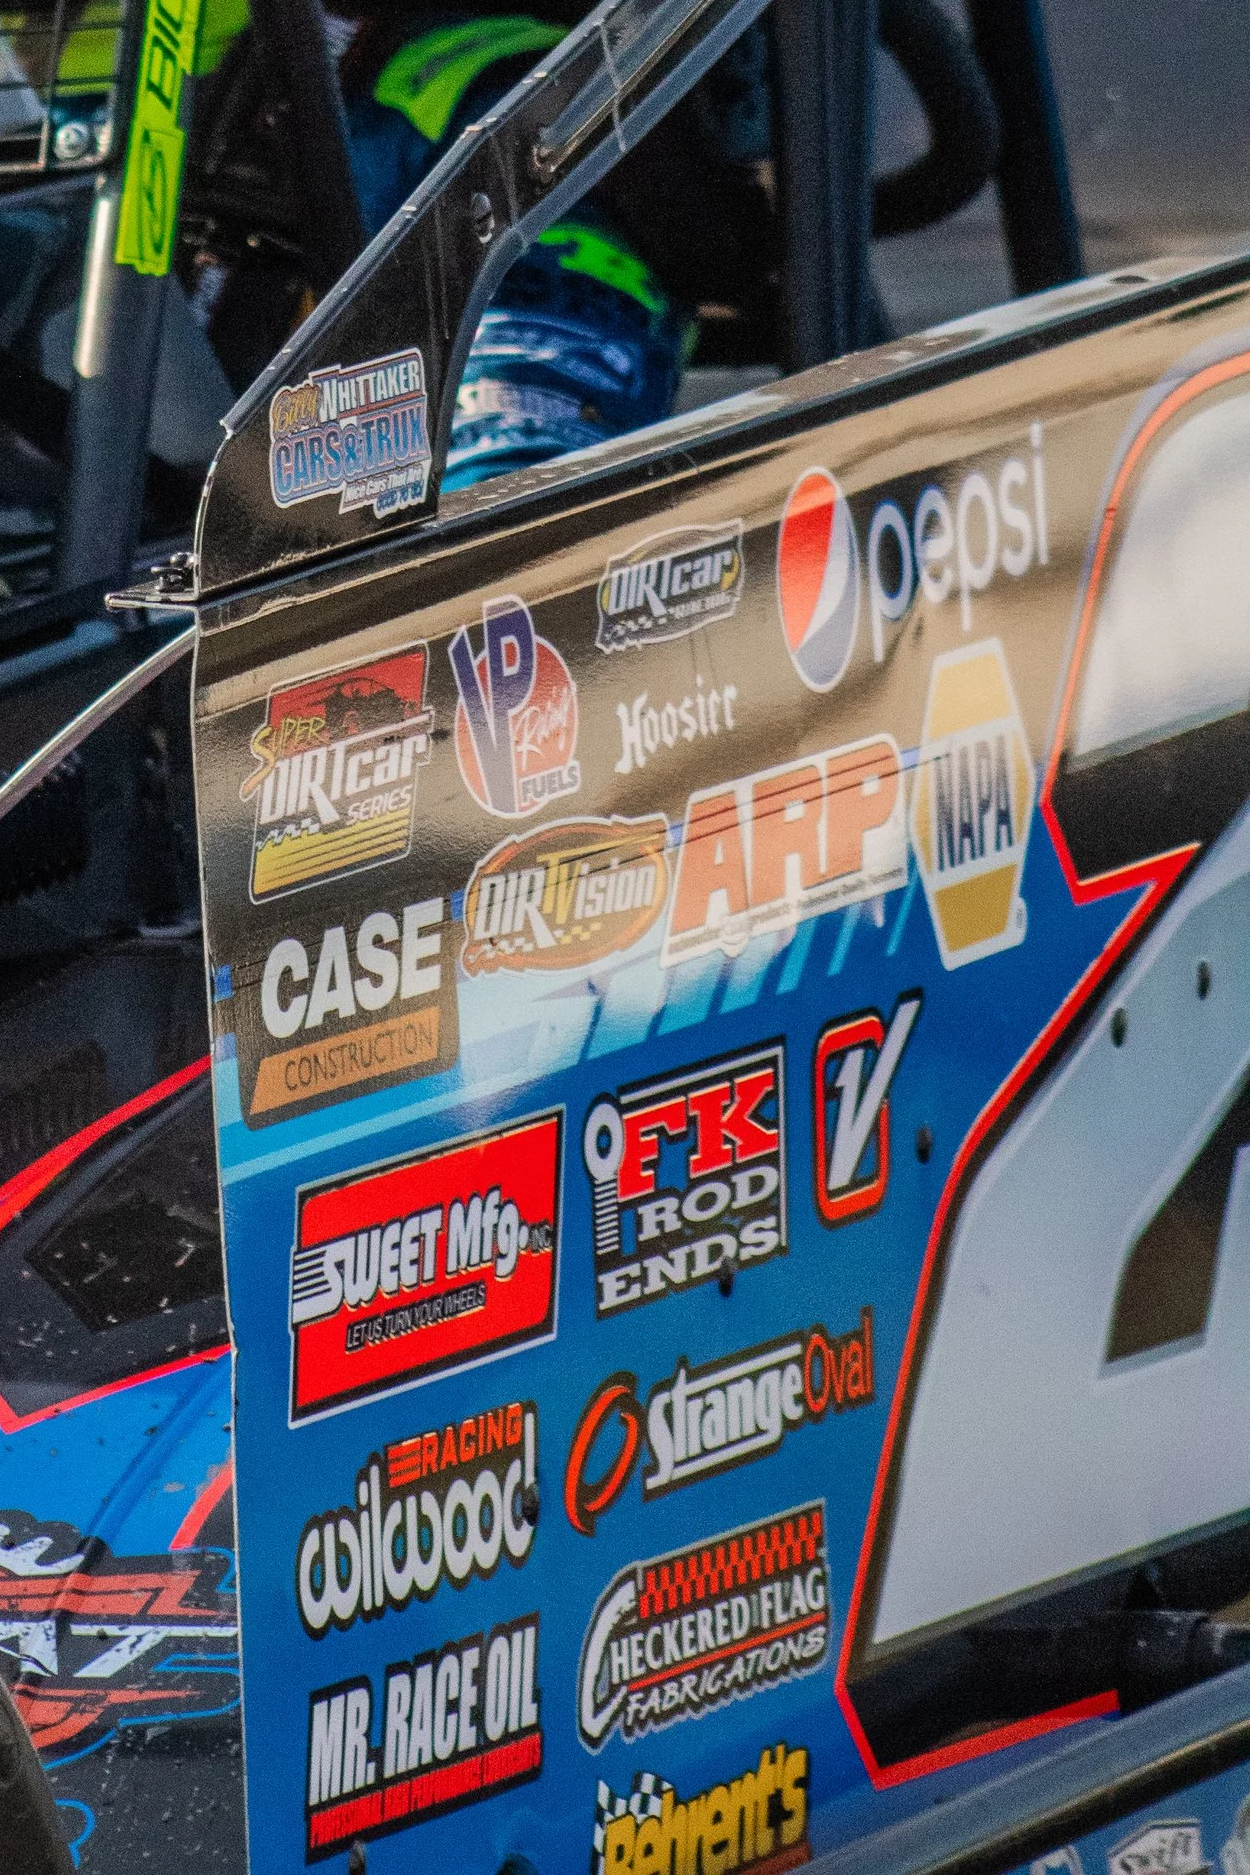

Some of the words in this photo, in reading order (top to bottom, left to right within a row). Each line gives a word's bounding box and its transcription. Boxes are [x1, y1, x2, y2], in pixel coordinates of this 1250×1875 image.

[318, 359, 421, 424] WHITTAKER
[607, 549, 735, 617] DIRTcar
[866, 419, 1051, 664] pepsi
[450, 597, 537, 816] VP
[259, 732, 428, 826] DIRTcar
[346, 783, 415, 826] SERIES
[521, 763, 580, 804] FUELS
[932, 733, 1016, 875] NAPA
[669, 741, 902, 937] ARP
[260, 896, 445, 1039] CASE
[283, 1020, 434, 1092] CONSTRUCTION
[616, 1067, 780, 1203] FK
[638, 1165, 781, 1242] ROD
[292, 1206, 443, 1325] SWEET
[597, 1216, 781, 1312] ENDS
[347, 1323, 367, 1349] LET
[367, 1319, 384, 1343] US
[382, 1310, 412, 1338] TURN
[411, 1299, 442, 1328] YOUR
[441, 1282, 487, 1320] WHEELS
[421, 1402, 524, 1477] RACING
[299, 1411, 538, 1629] wilwood
[581, 1580, 748, 1738] CHECKERED
[759, 1566, 825, 1629] FLAG
[626, 1627, 827, 1726] FABRICATIONS
[308, 1687, 376, 1807] MR.
[383, 1645, 480, 1780] RACE
[484, 1626, 538, 1742] OIL
